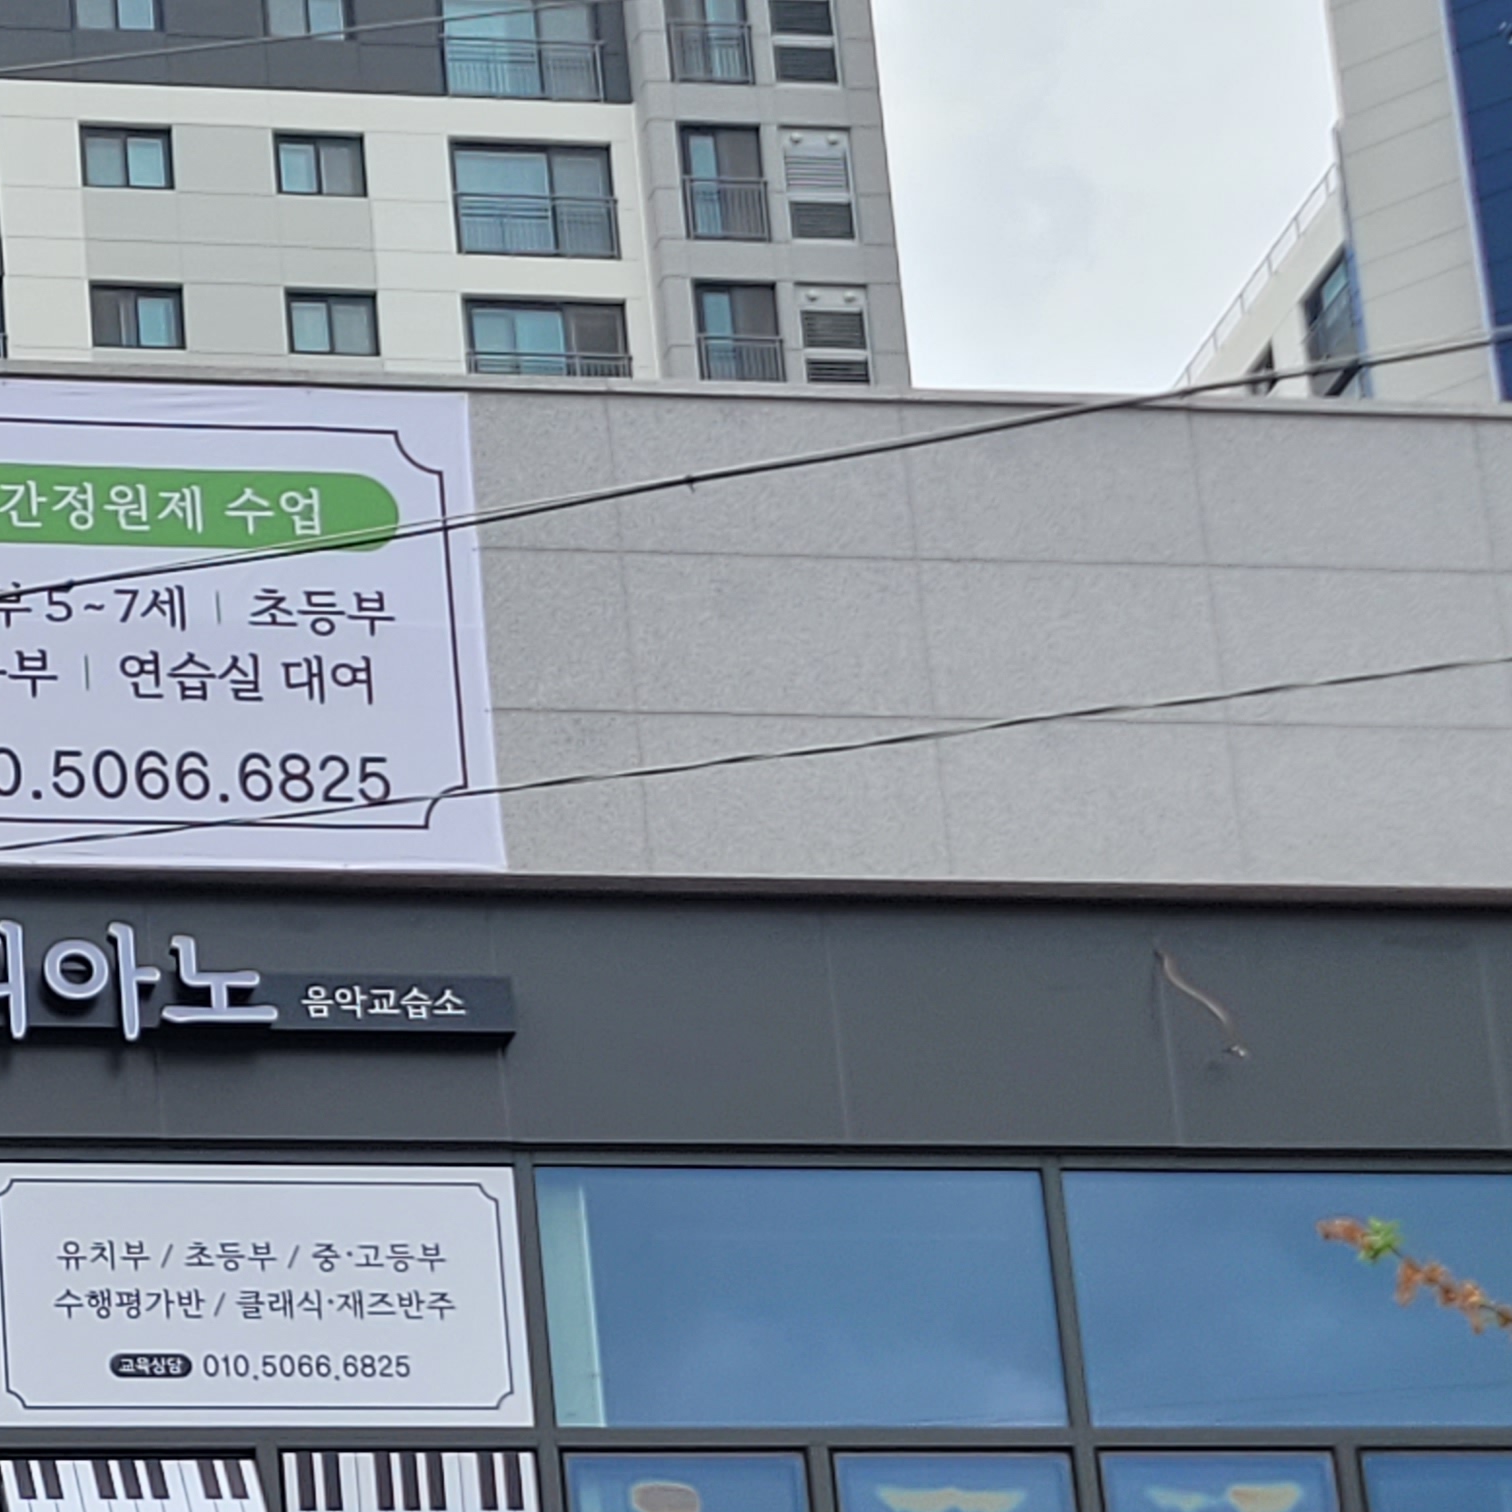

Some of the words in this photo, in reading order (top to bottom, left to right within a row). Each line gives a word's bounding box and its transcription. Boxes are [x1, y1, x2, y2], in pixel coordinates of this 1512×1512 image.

[223, 487, 323, 536] 수업
[45, 584, 186, 631] 5~7세
[248, 588, 395, 636] 초등부
[120, 650, 263, 702] 연습실
[283, 654, 374, 705] 대여
[300, 984, 469, 1019] 음악교습소
[57, 1240, 150, 1273] 유치부
[184, 1242, 278, 1273] 초등부
[311, 1243, 448, 1274] 중·고등부
[54, 1288, 205, 1320] 수행평가반
[235, 1289, 456, 1322] 클래식·재즈반주
[118, 1357, 183, 1375] 교육상담
[202, 1354, 411, 1382] 010.5066.6825
